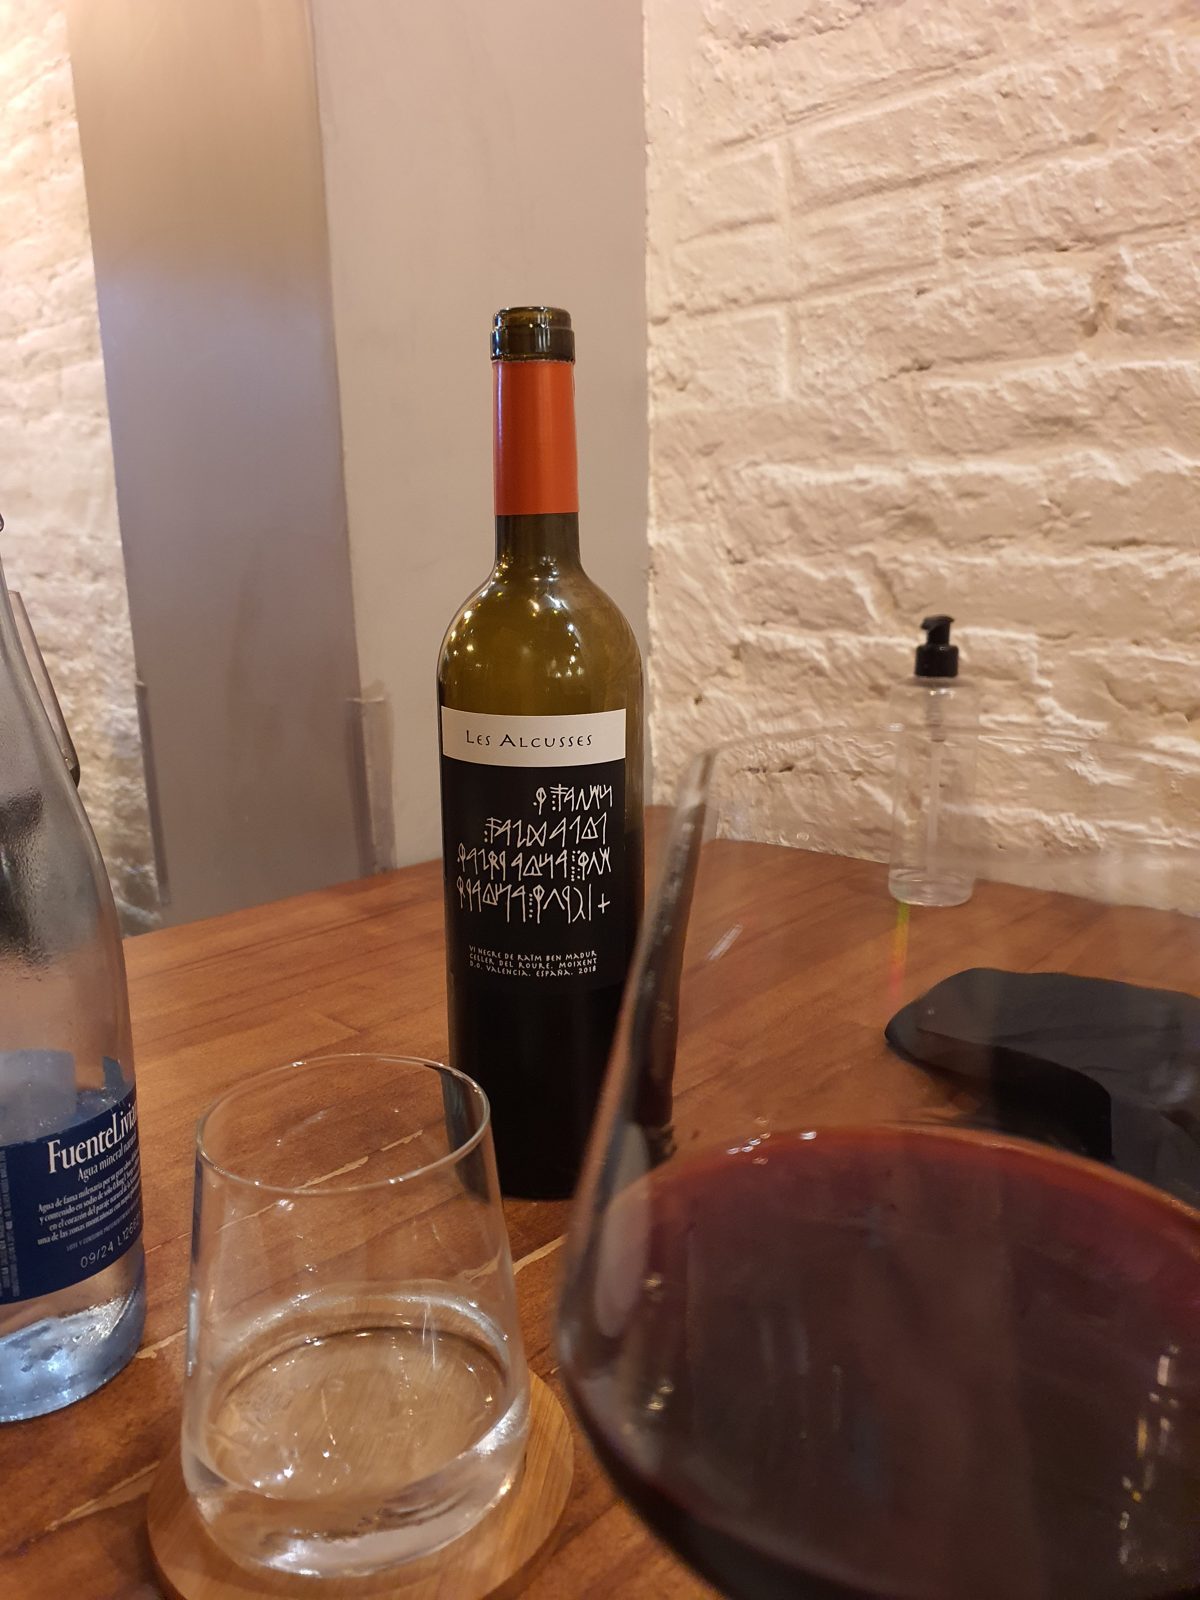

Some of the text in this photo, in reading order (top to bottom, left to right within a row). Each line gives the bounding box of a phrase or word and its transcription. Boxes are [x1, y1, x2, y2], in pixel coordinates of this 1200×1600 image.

[500, 733, 593, 748] ALCUSSES
[469, 953, 495, 965] CELLER
[499, 959, 514, 968] DEL
[558, 957, 597, 969] MOIXENT
[477, 947, 501, 959] NEGRE
[504, 952, 514, 960] DE
[545, 954, 562, 962] BEN
[565, 949, 597, 961] MADUR
[578, 964, 597, 975] 2018
[78, 1163, 98, 1183] Agua
[99, 1142, 123, 1170] mineral
[55, 1197, 63, 1207] de
[58, 1218, 64, 1228] el
[80, 1241, 114, 1269] 09/24
